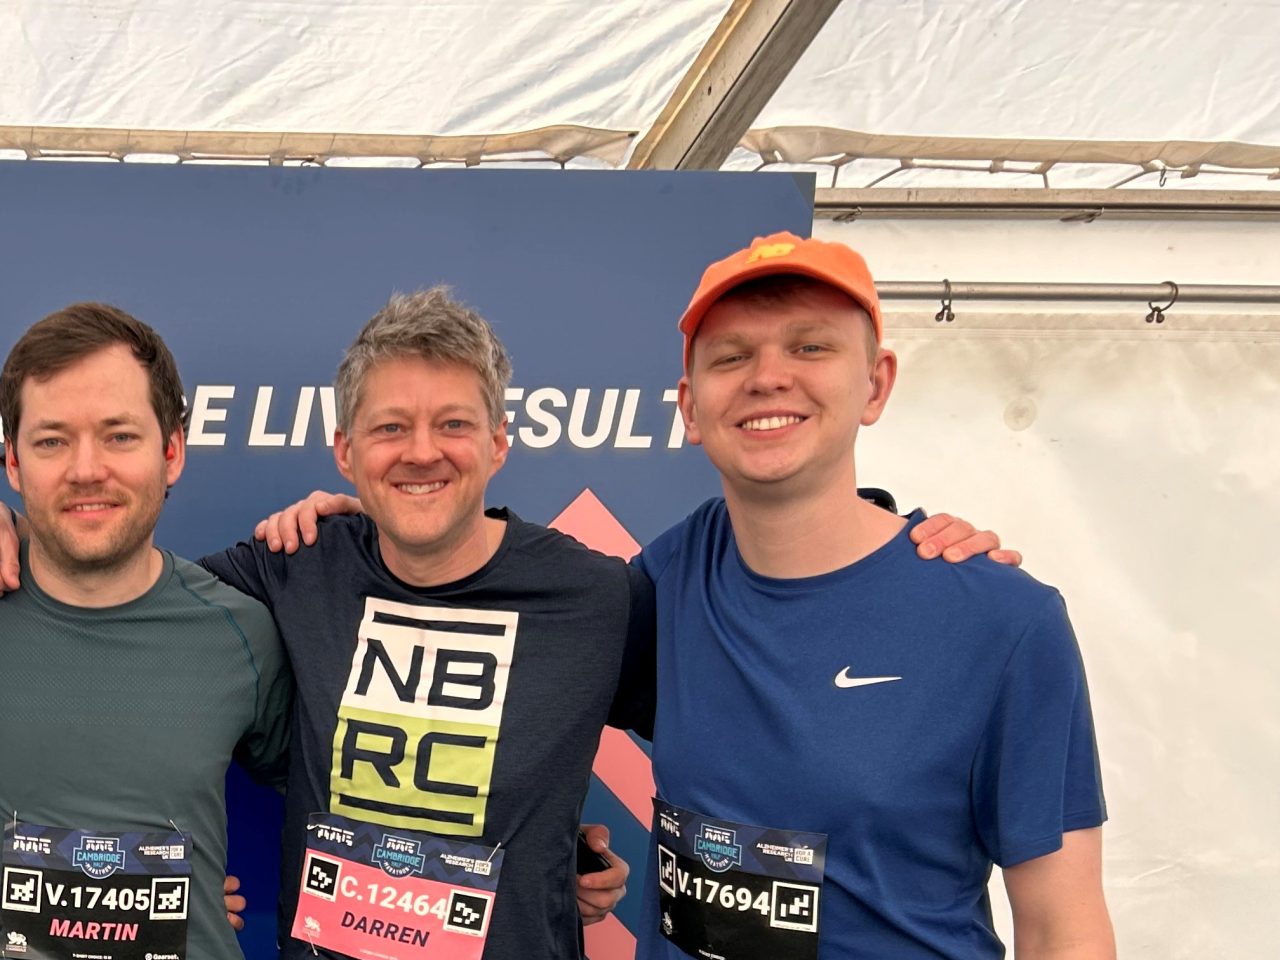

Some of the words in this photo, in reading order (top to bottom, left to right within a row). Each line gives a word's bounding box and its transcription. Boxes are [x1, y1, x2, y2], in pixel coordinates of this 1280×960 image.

[354, 637, 498, 711] NB
[340, 718, 488, 798] RC
[76, 850, 121, 864] CAMBRIDGE
[376, 847, 421, 868] CAMBRIDGE
[697, 839, 738, 859] CAMBRIDGE
[84, 862, 113, 876] MARATHON
[45, 882, 150, 911] V.17405
[340, 875, 447, 919] C.12464
[677, 867, 771, 916] V.17694
[49, 918, 139, 942] MARTIN
[341, 911, 431, 947] DARREN
